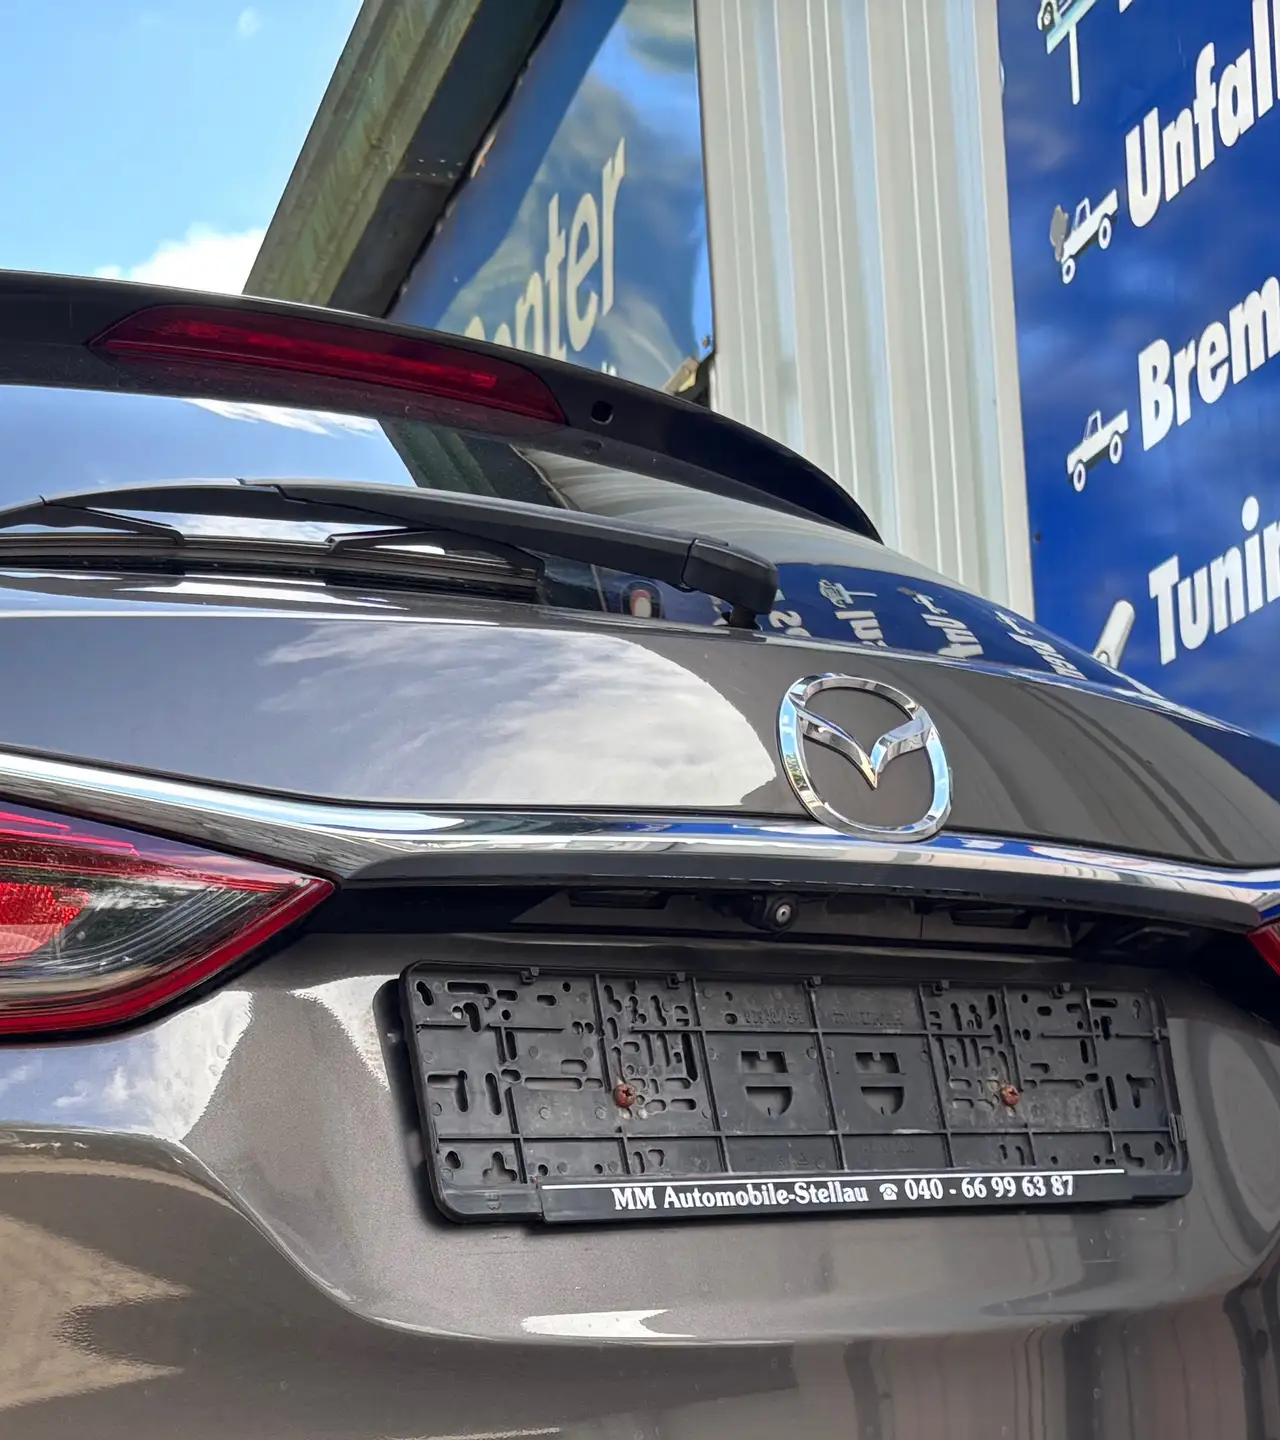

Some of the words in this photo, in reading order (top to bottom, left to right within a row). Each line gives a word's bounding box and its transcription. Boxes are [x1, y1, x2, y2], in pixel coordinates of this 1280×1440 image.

[464, 137, 625, 360] nter
[612, 1187, 656, 1211] MM
[663, 1182, 869, 1210] Automobile-Stellau
[904, 1178, 941, 1201] 040
[961, 1177, 987, 1199] 66
[991, 1176, 1016, 1198] 99
[1022, 1176, 1047, 1197] 63
[1051, 1175, 1075, 1197] 87
